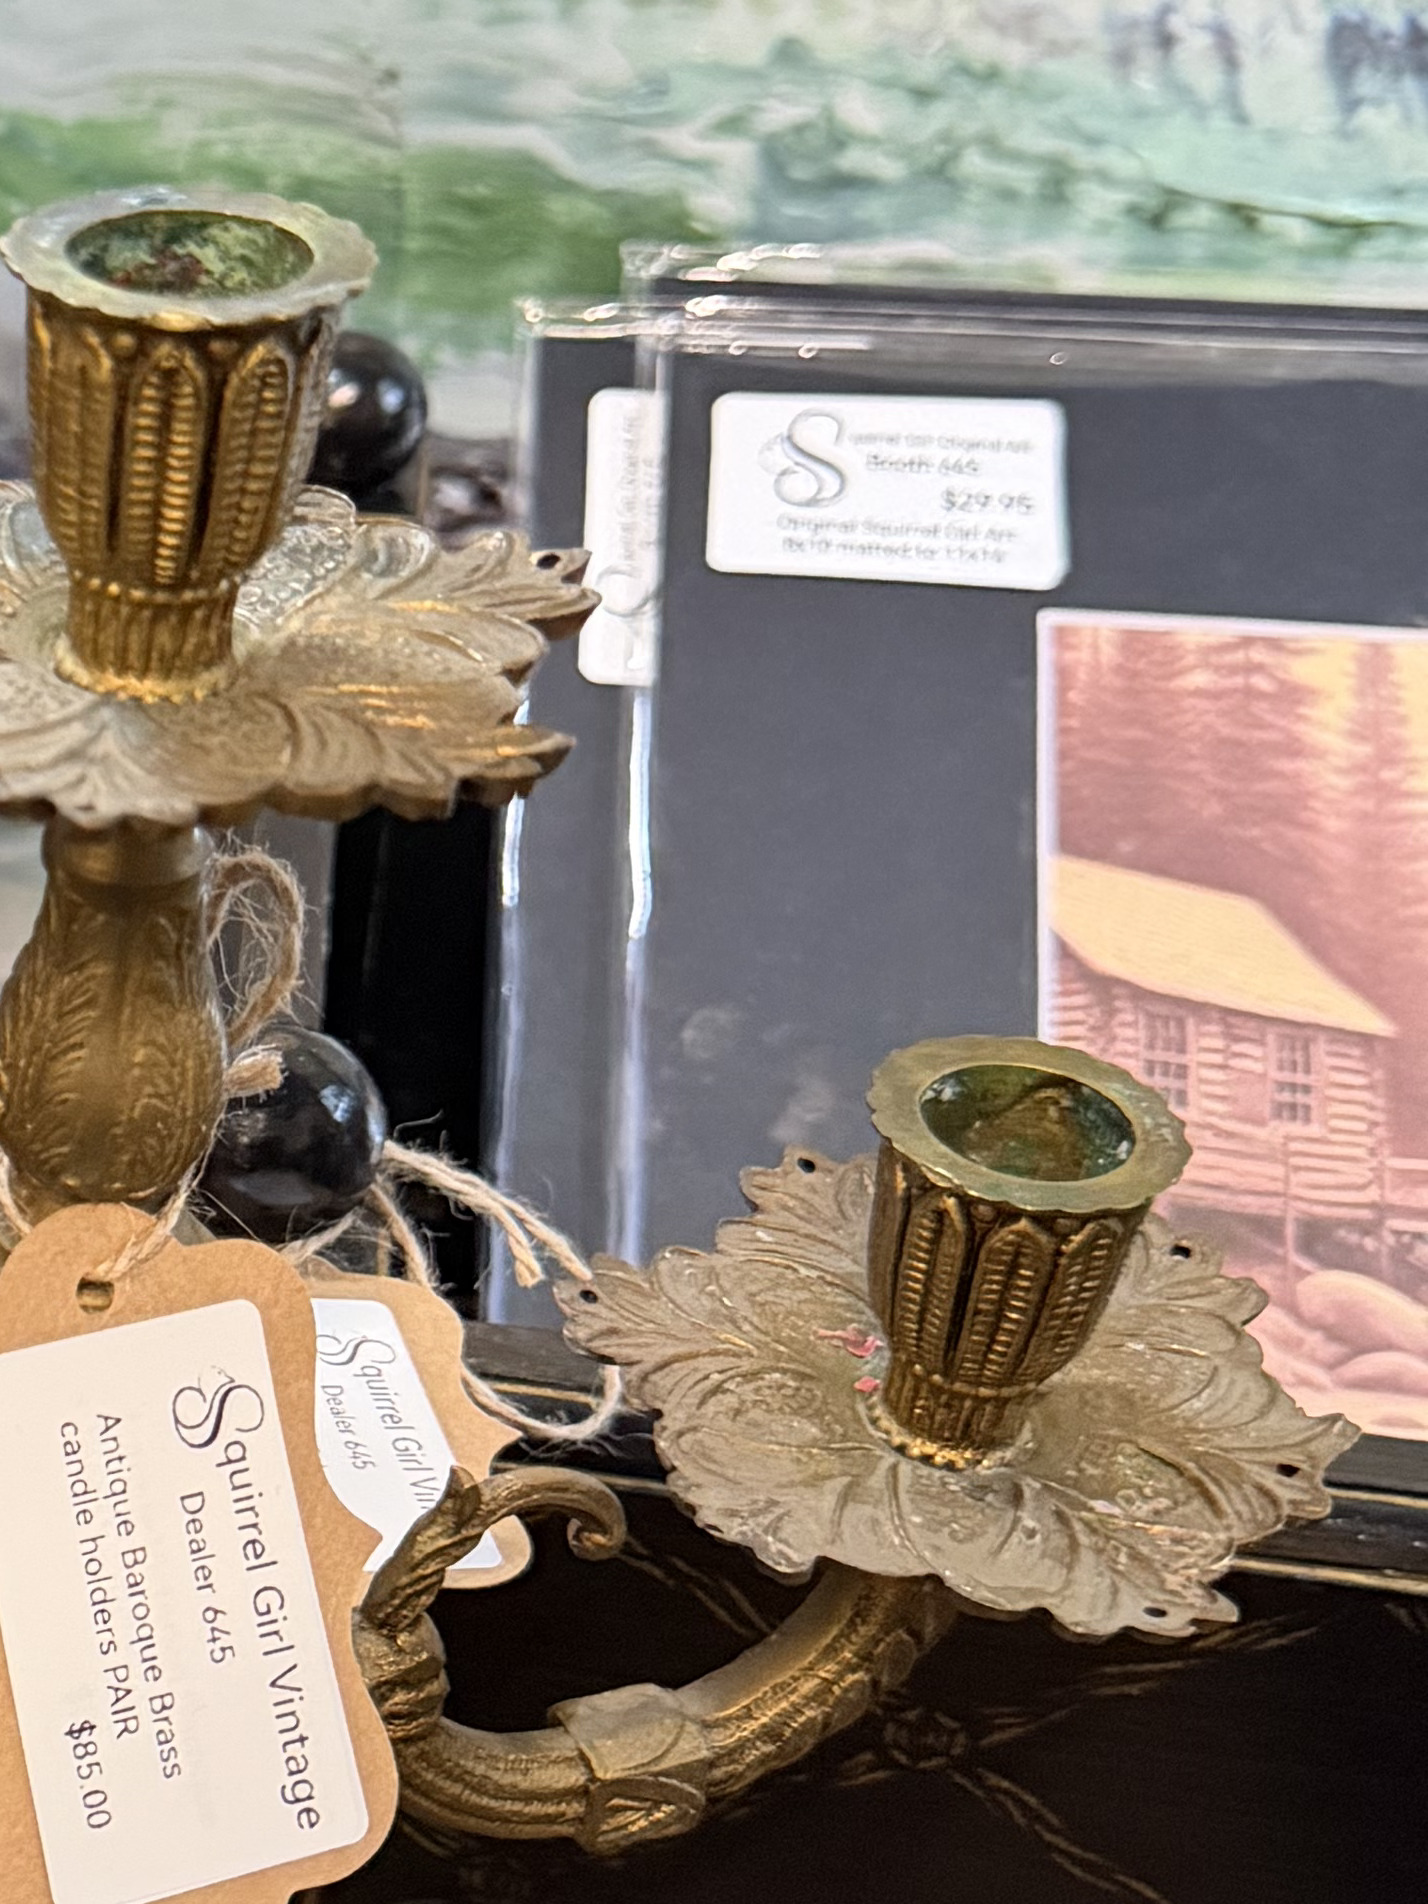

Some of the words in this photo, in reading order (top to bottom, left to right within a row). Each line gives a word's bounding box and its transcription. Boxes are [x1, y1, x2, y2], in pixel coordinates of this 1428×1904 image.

[866, 454, 932, 473] Booth
[940, 488, 1036, 514] $29.95
[777, 512, 857, 537] Original
[860, 517, 942, 540] Squirrel
[837, 539, 913, 559] matted
[316, 1334, 415, 1430] Squirrel
[392, 1437, 434, 1471] Girl
[321, 1385, 356, 1435] Dealer
[344, 1440, 376, 1470] 645
[60, 1421, 95, 1527] candle
[172, 1381, 278, 1574] Squirrel
[77, 1533, 118, 1657] holders
[95, 1412, 135, 1538] Antique
[120, 1547, 162, 1685] Baroque
[148, 1691, 182, 1780] Brass
[179, 1491, 217, 1596] Dealer
[201, 1605, 235, 1665] 645
[251, 1585, 295, 1657] Girl
[103, 1668, 139, 1740] PAIR
[267, 1664, 321, 1832] Vintage
[64, 1721, 112, 1831] $85.00
